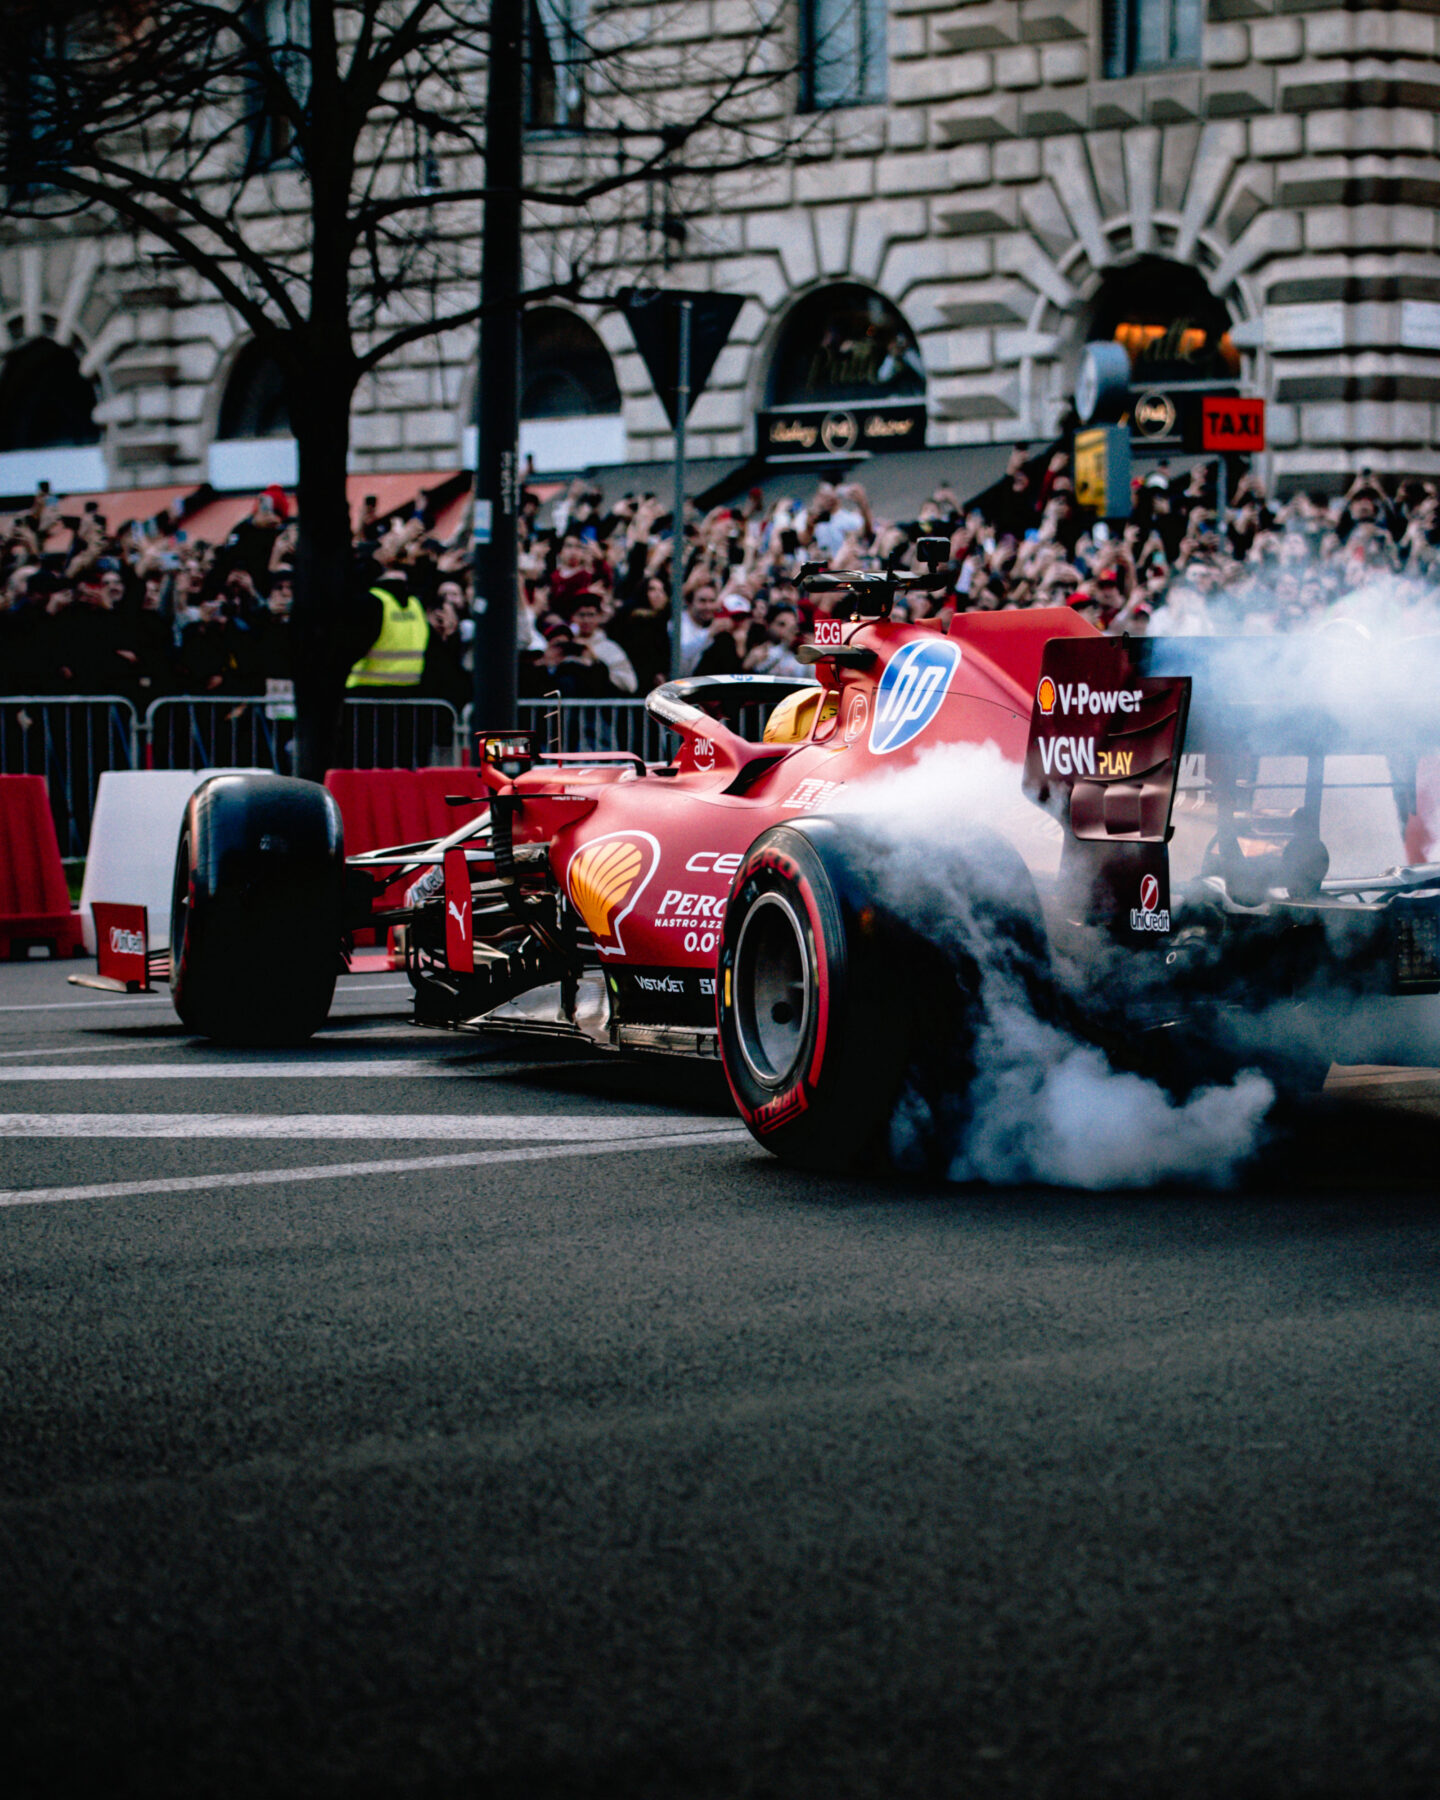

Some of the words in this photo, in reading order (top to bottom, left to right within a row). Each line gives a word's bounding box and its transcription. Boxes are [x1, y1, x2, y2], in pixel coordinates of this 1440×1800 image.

[1208, 412, 1260, 434] TAXI
[814, 622, 841, 644] ZCG
[879, 640, 947, 750] hp
[1058, 682, 1144, 715] V-Power
[694, 737, 715, 756] aws
[1038, 736, 1095, 775] VGW
[1097, 751, 1134, 775] PLAY
[654, 918, 698, 928] NASTRO
[1130, 908, 1170, 933] UniCredit
